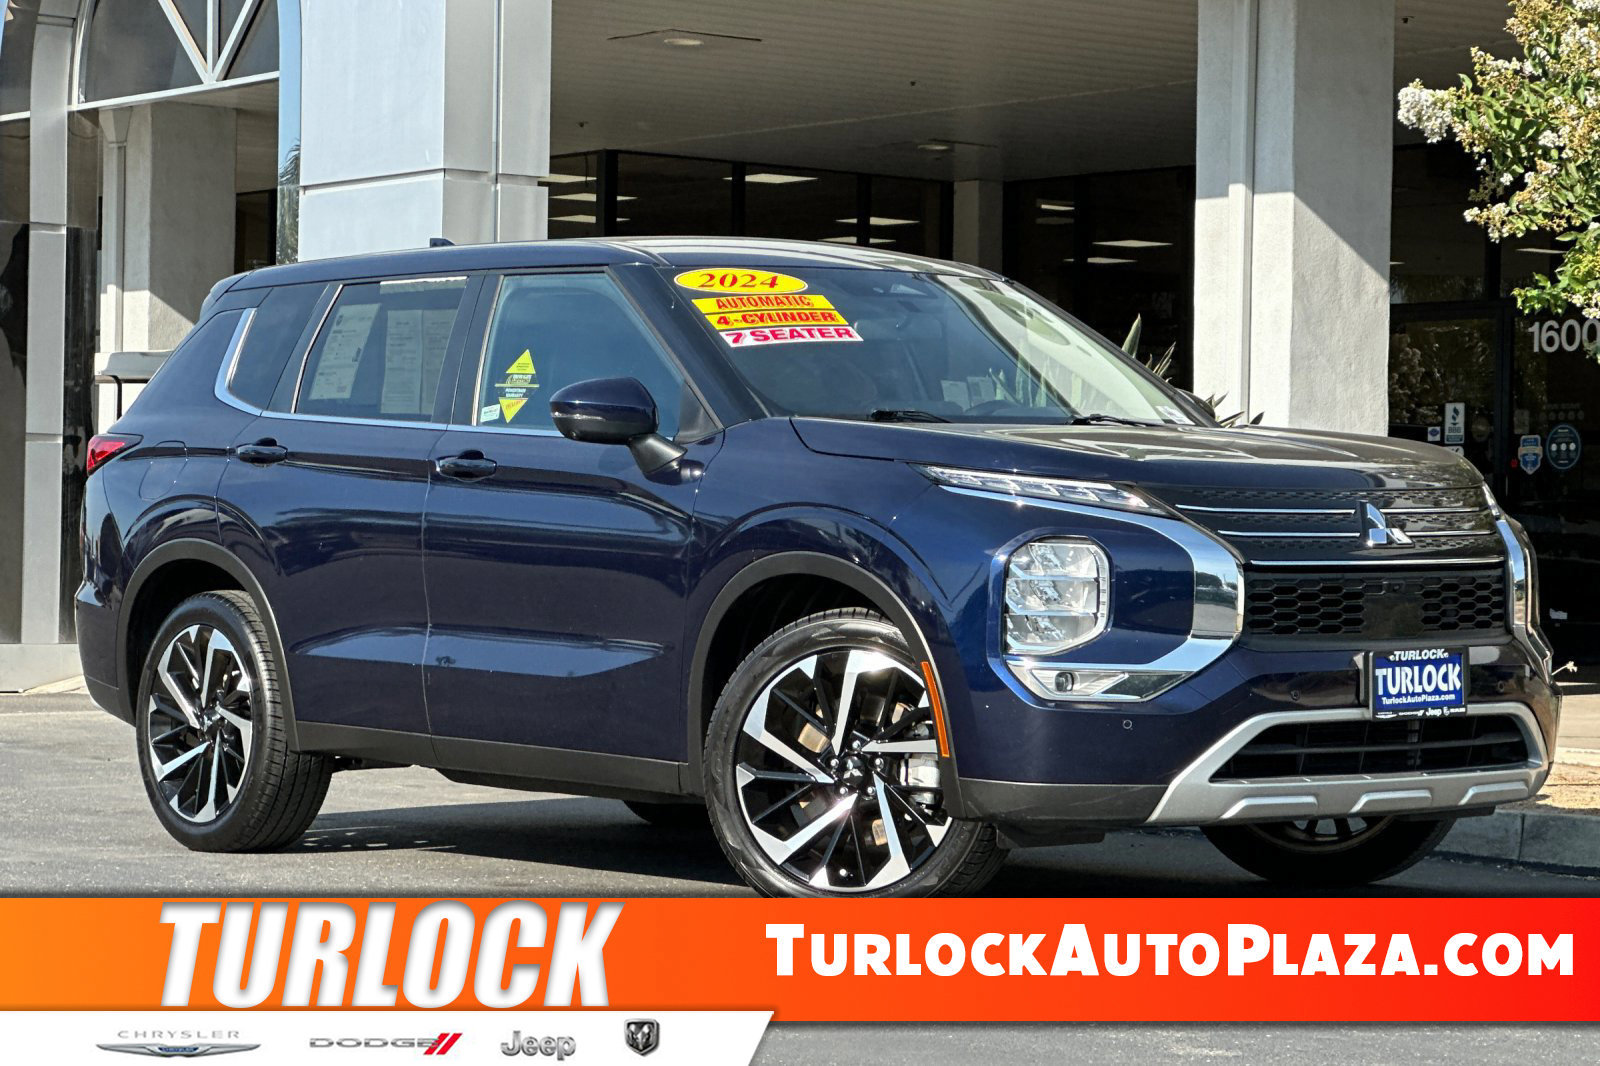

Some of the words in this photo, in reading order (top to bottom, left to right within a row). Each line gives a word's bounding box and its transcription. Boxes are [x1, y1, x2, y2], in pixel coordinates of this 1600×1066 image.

[698, 273, 779, 289] 2024
[716, 294, 814, 310] AUTOMATIC
[716, 311, 838, 326] 4-CYLINDER
[725, 332, 745, 345] 7
[749, 327, 856, 343] SEATER
[1393, 648, 1445, 662] TURLOCK
[1375, 663, 1461, 696] TURLOCK
[1381, 693, 1455, 705] TurlockAutoPlaza.com
